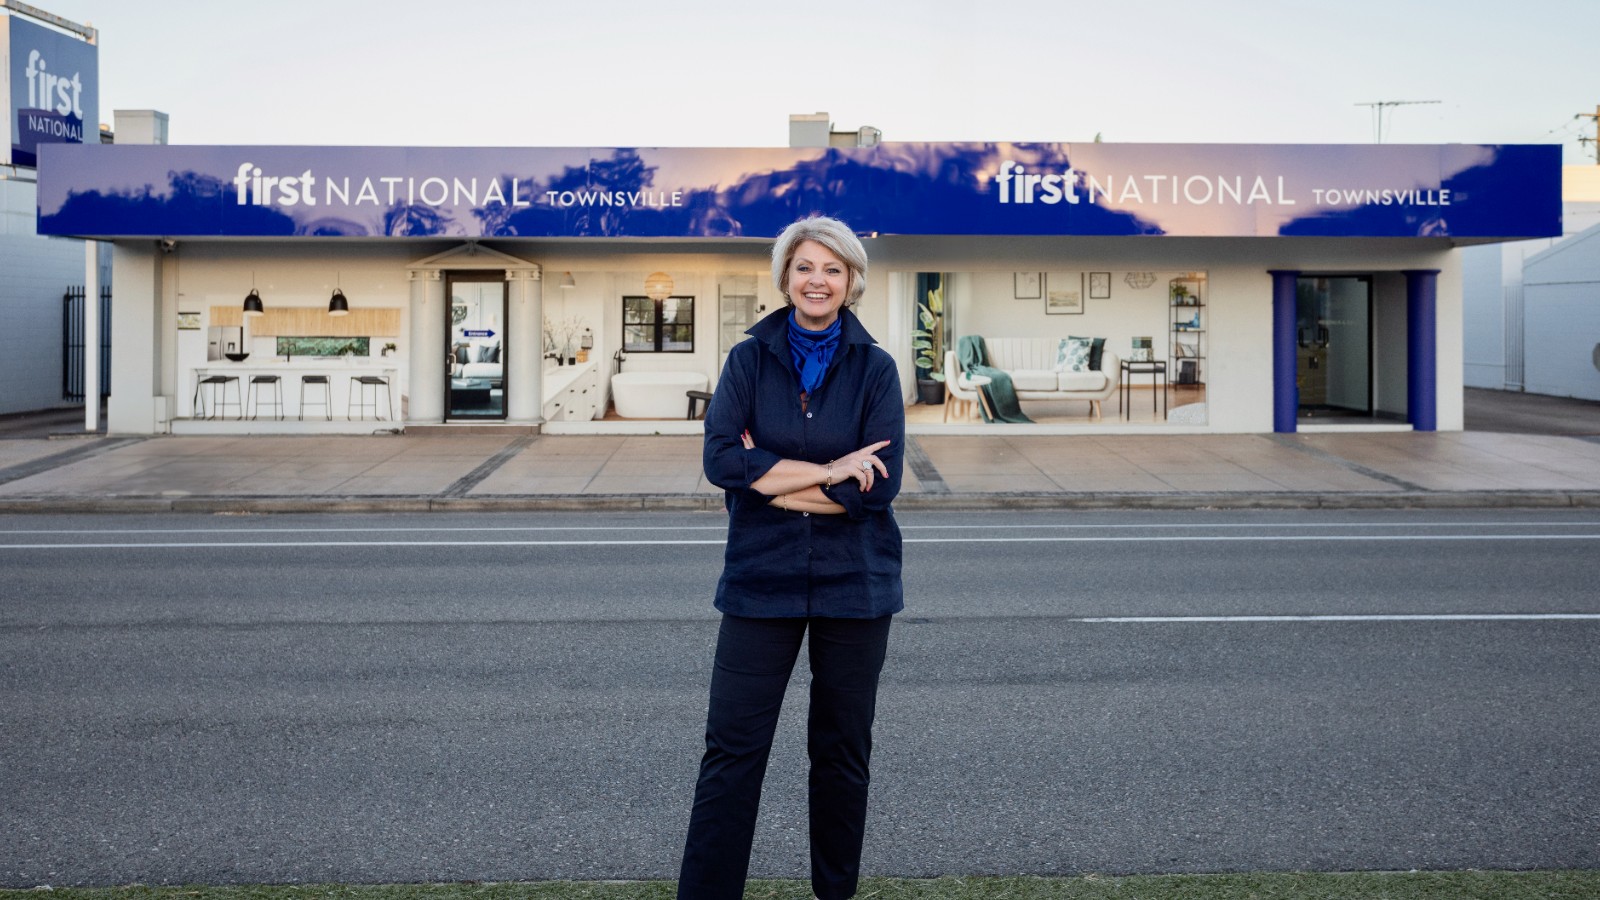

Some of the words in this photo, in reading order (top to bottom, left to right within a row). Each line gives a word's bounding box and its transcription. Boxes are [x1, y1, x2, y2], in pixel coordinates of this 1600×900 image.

[26, 49, 83, 120] first
[29, 114, 83, 140] NATIONAL
[233, 162, 316, 206] first
[326, 176, 530, 206] NATIONAL
[546, 191, 683, 207] TOWNSVILLE
[995, 160, 1080, 204] first
[1089, 175, 1296, 205] NATIONAL
[1312, 189, 1451, 205] TOWNSVILLE
